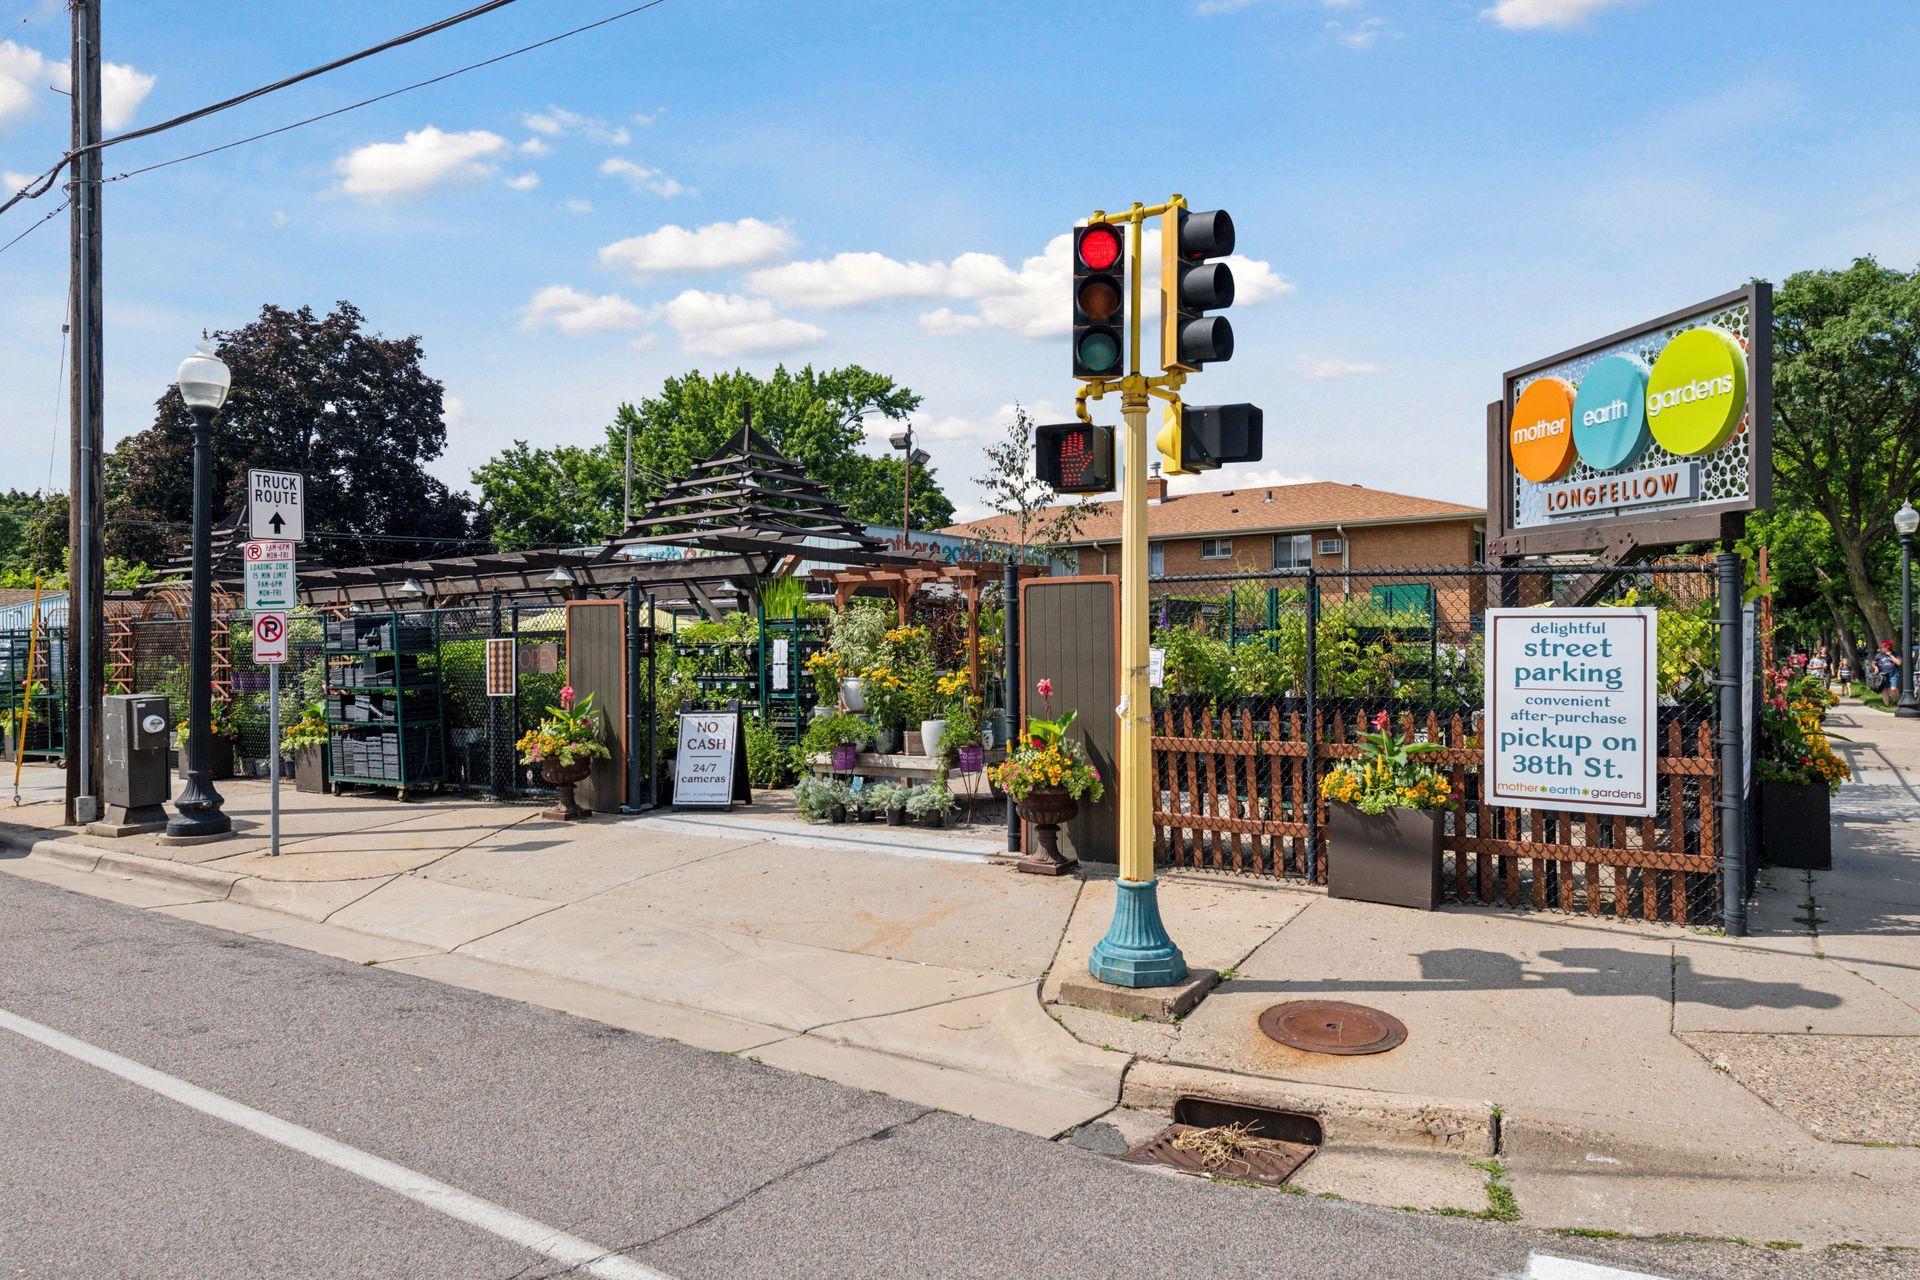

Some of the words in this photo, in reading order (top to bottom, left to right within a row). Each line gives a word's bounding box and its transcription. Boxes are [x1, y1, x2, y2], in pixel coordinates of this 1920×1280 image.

[1513, 417, 1567, 446] mother
[1582, 398, 1629, 428] earth
[1647, 373, 1733, 417] gardens
[255, 474, 297, 491] TRUCK
[255, 489, 298, 505] ROUTE
[1546, 472, 1679, 512] LONGFELLOW
[266, 551, 289, 559] MON-FRI
[250, 563, 272, 571] LOADING
[275, 562, 289, 570] ZONE
[273, 571, 287, 579] LIMIT
[257, 580, 283, 588] 9AM-6PM
[258, 589, 282, 597] MON-FRI
[1530, 621, 1606, 638] delightful
[1524, 637, 1613, 658] street
[520, 648, 558, 670] OPEN
[1514, 660, 1624, 690] parking
[1525, 695, 1612, 708] convenient
[1510, 709, 1628, 726] after-purchase
[697, 721, 719, 733] NO
[687, 738, 727, 750] CASH
[1501, 726, 1593, 757] pickup
[1602, 735, 1638, 752] on
[692, 763, 717, 773] 24/7
[1512, 754, 1573, 776] 38th
[1584, 757, 1624, 780] St.
[681, 776, 727, 784] cameras
[1497, 782, 1539, 793] mother
[1549, 785, 1581, 796] earth
[1591, 788, 1642, 800] gardens
